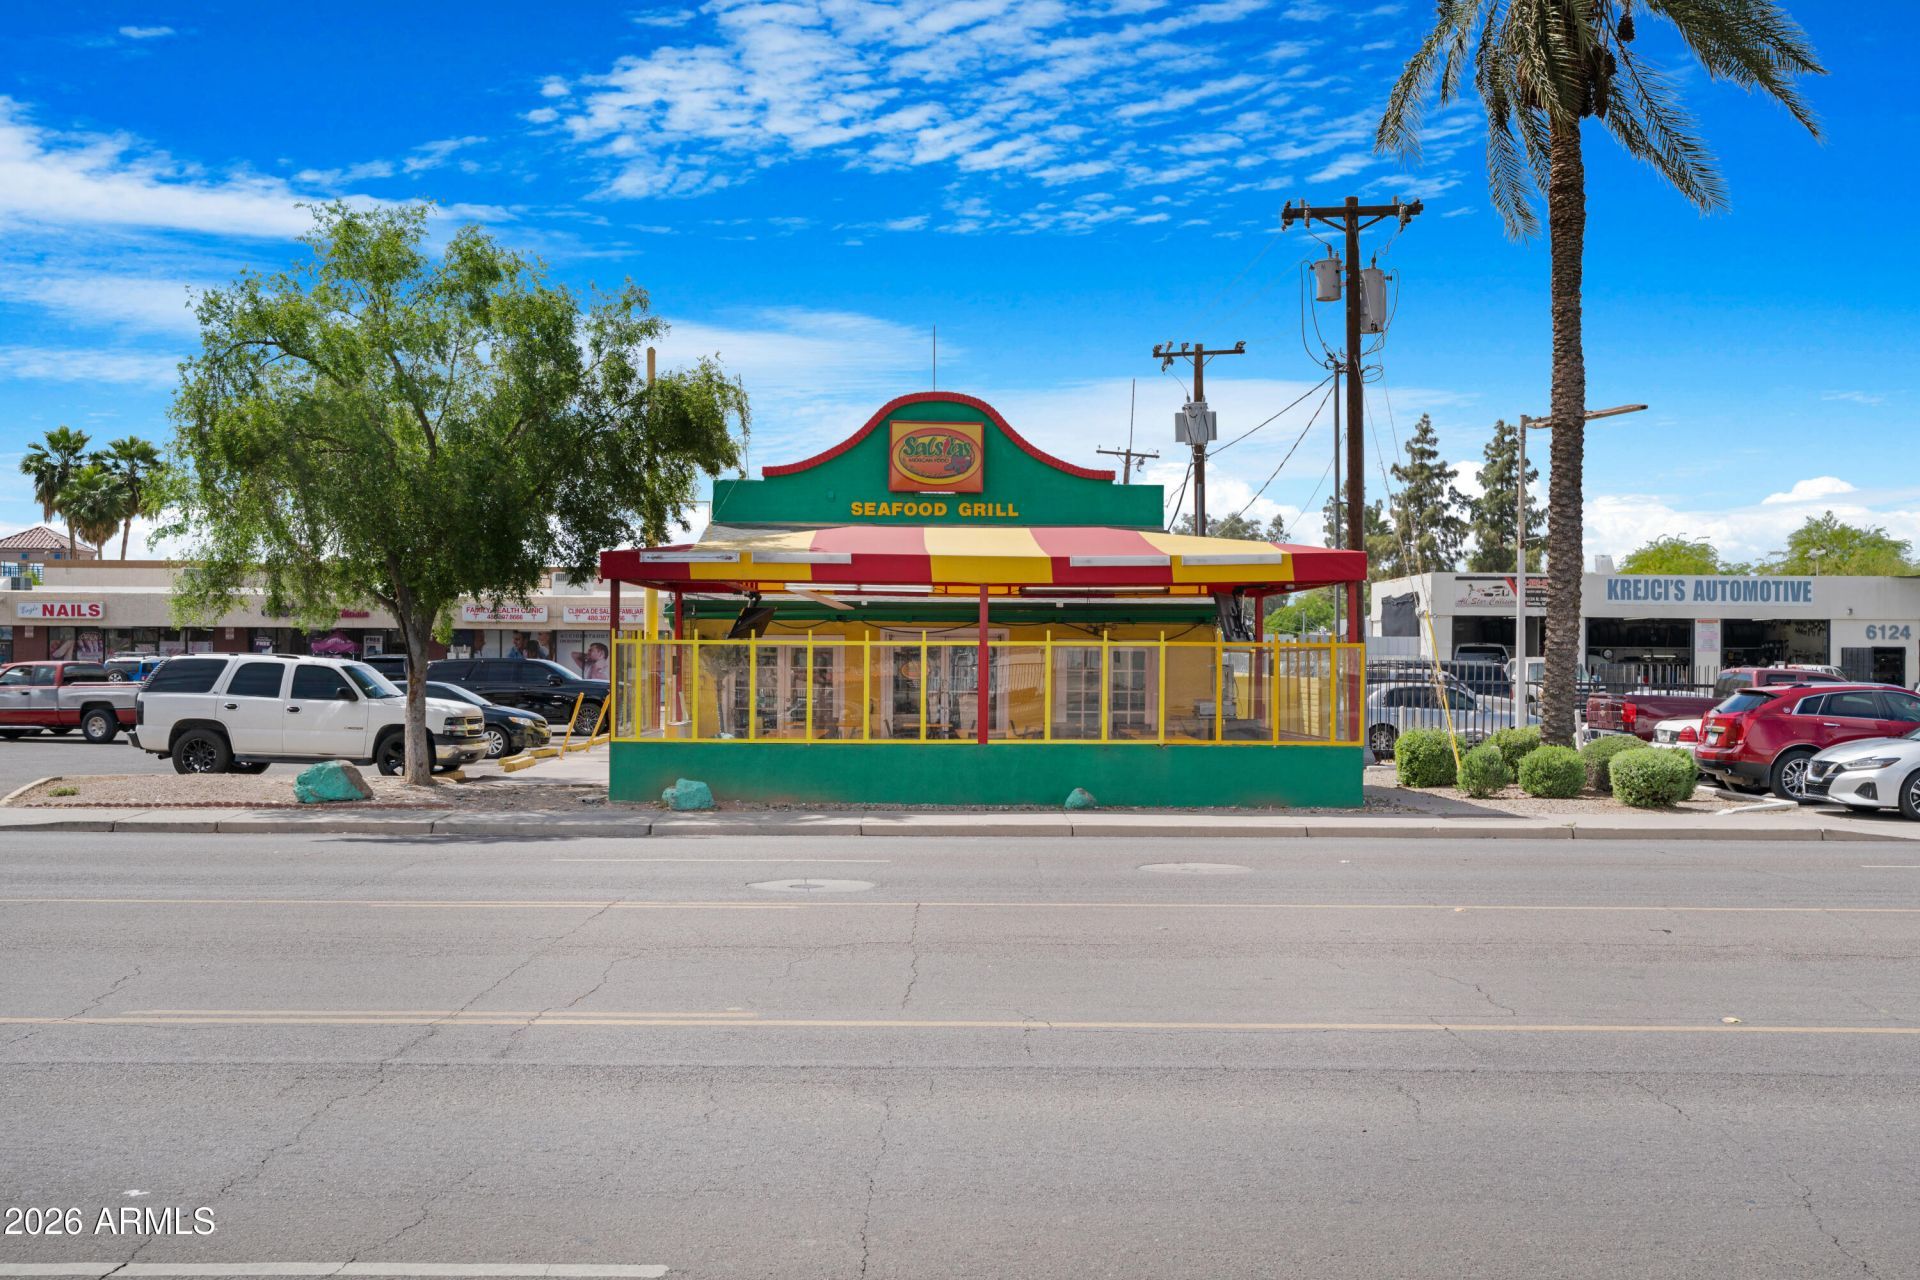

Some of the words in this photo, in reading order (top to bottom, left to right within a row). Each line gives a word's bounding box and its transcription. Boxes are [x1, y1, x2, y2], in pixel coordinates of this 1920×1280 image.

[851, 501, 948, 516] SEAFOOD
[958, 502, 1019, 517] GRILL
[1607, 578, 1686, 602] KREJCI'S
[1693, 579, 1812, 602] AUTOMOTIVE
[42, 604, 101, 617] NAILS
[1865, 624, 1912, 640] 6124
